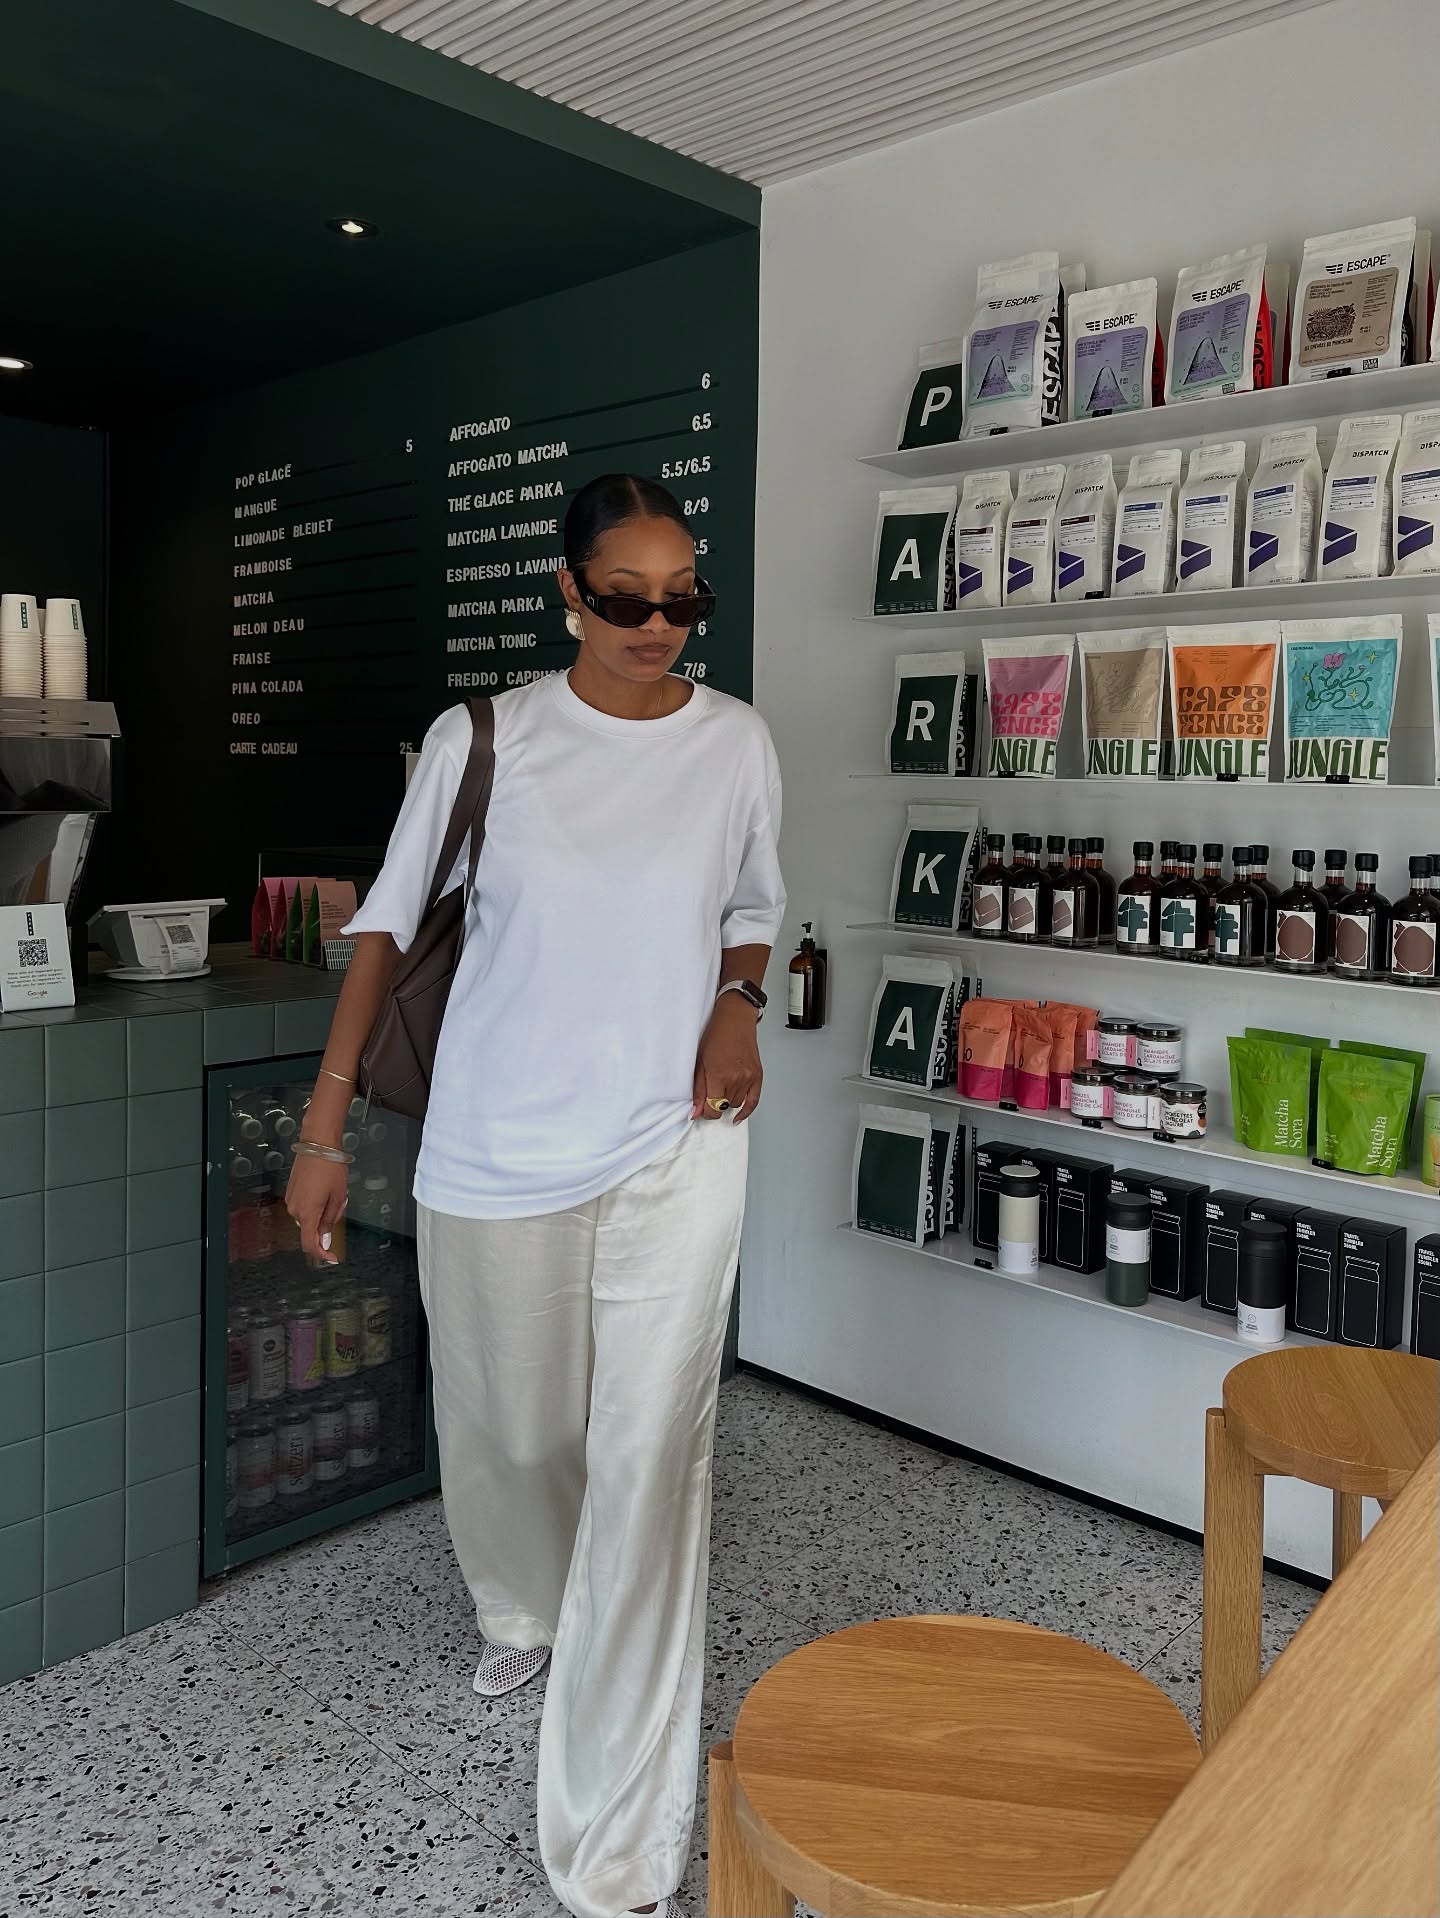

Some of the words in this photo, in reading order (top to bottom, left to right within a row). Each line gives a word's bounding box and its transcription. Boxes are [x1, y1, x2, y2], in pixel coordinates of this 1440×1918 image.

[1347, 255, 1387, 272] ESCAPE
[1210, 282, 1241, 300] ESCAPE
[1005, 295, 1041, 307] ESCAPE
[1103, 316, 1135, 329] ESCAPE
[702, 373, 710, 389] 6
[920, 386, 952, 426] P
[450, 417, 510, 441] AFFOGATO
[692, 413, 711, 431] 6.5
[406, 439, 412, 452] 5
[1352, 449, 1388, 458] DISPATCH
[448, 456, 511, 477] AFFOGATO
[518, 442, 568, 464] MATCHA
[662, 456, 710, 478] 5.5/6.5
[1273, 458, 1305, 469] DISPATCH
[236, 474, 254, 489] POP
[1074, 485, 1104, 494] DISPATCH
[474, 489, 513, 508] GLACE
[520, 481, 563, 501] PARKA
[1028, 494, 1055, 503] DISPATCH
[235, 499, 277, 518] MANGUE
[684, 497, 709, 516] 8/9
[976, 500, 1001, 510] DISPATCH
[235, 528, 285, 547] LIMONADE
[293, 519, 333, 537] BLEUET
[448, 528, 496, 546] MATCHA
[501, 519, 557, 539] LAVANDE
[694, 540, 708, 554] .5
[234, 558, 292, 577] FRAMBOISE
[890, 538, 921, 581] A
[447, 563, 510, 582] ESPRESSO
[234, 592, 274, 607] MATCHA
[448, 601, 496, 617] MATCHA
[502, 596, 544, 613] PARKA
[234, 622, 267, 636] MELON
[274, 619, 304, 632] DEAU
[698, 621, 706, 636] 6
[447, 637, 495, 652] MATCHA
[499, 633, 536, 648] TONIC
[233, 652, 270, 665] FRAISE
[448, 671, 498, 687] FREDDO
[684, 663, 705, 678] 7/8
[233, 682, 256, 694] PINA
[262, 680, 303, 692] COLADA
[232, 713, 260, 724] OREO
[906, 700, 935, 741] R
[230, 743, 256, 754] CARTE
[262, 743, 297, 754] CADEAU
[400, 743, 412, 755] 25
[1287, 739, 1388, 780] JUNGLE
[912, 852, 946, 894] K
[886, 1006, 915, 1050] A
[1274, 1099, 1289, 1147] Matcha
[1289, 1118, 1303, 1149] Sora
[1366, 1116, 1388, 1167] Matcha
[1379, 1137, 1398, 1168] Sora
